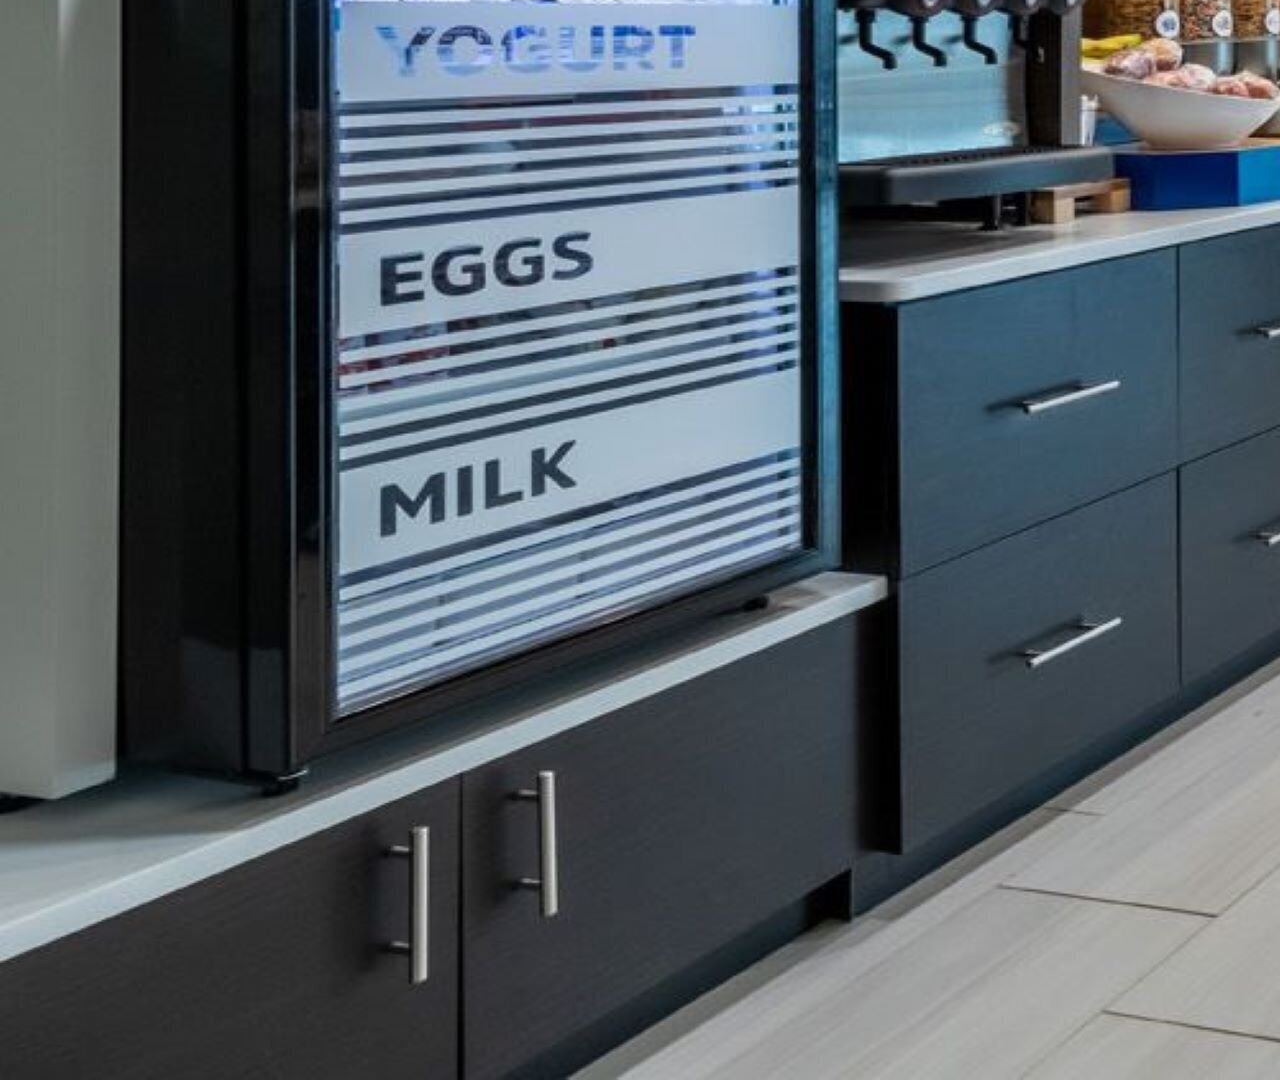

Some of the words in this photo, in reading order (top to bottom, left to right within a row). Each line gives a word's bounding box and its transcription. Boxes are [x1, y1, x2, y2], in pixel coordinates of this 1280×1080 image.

[374, 23, 697, 78] YOGURT
[380, 231, 594, 307] EGGS
[380, 439, 578, 538] MILK
